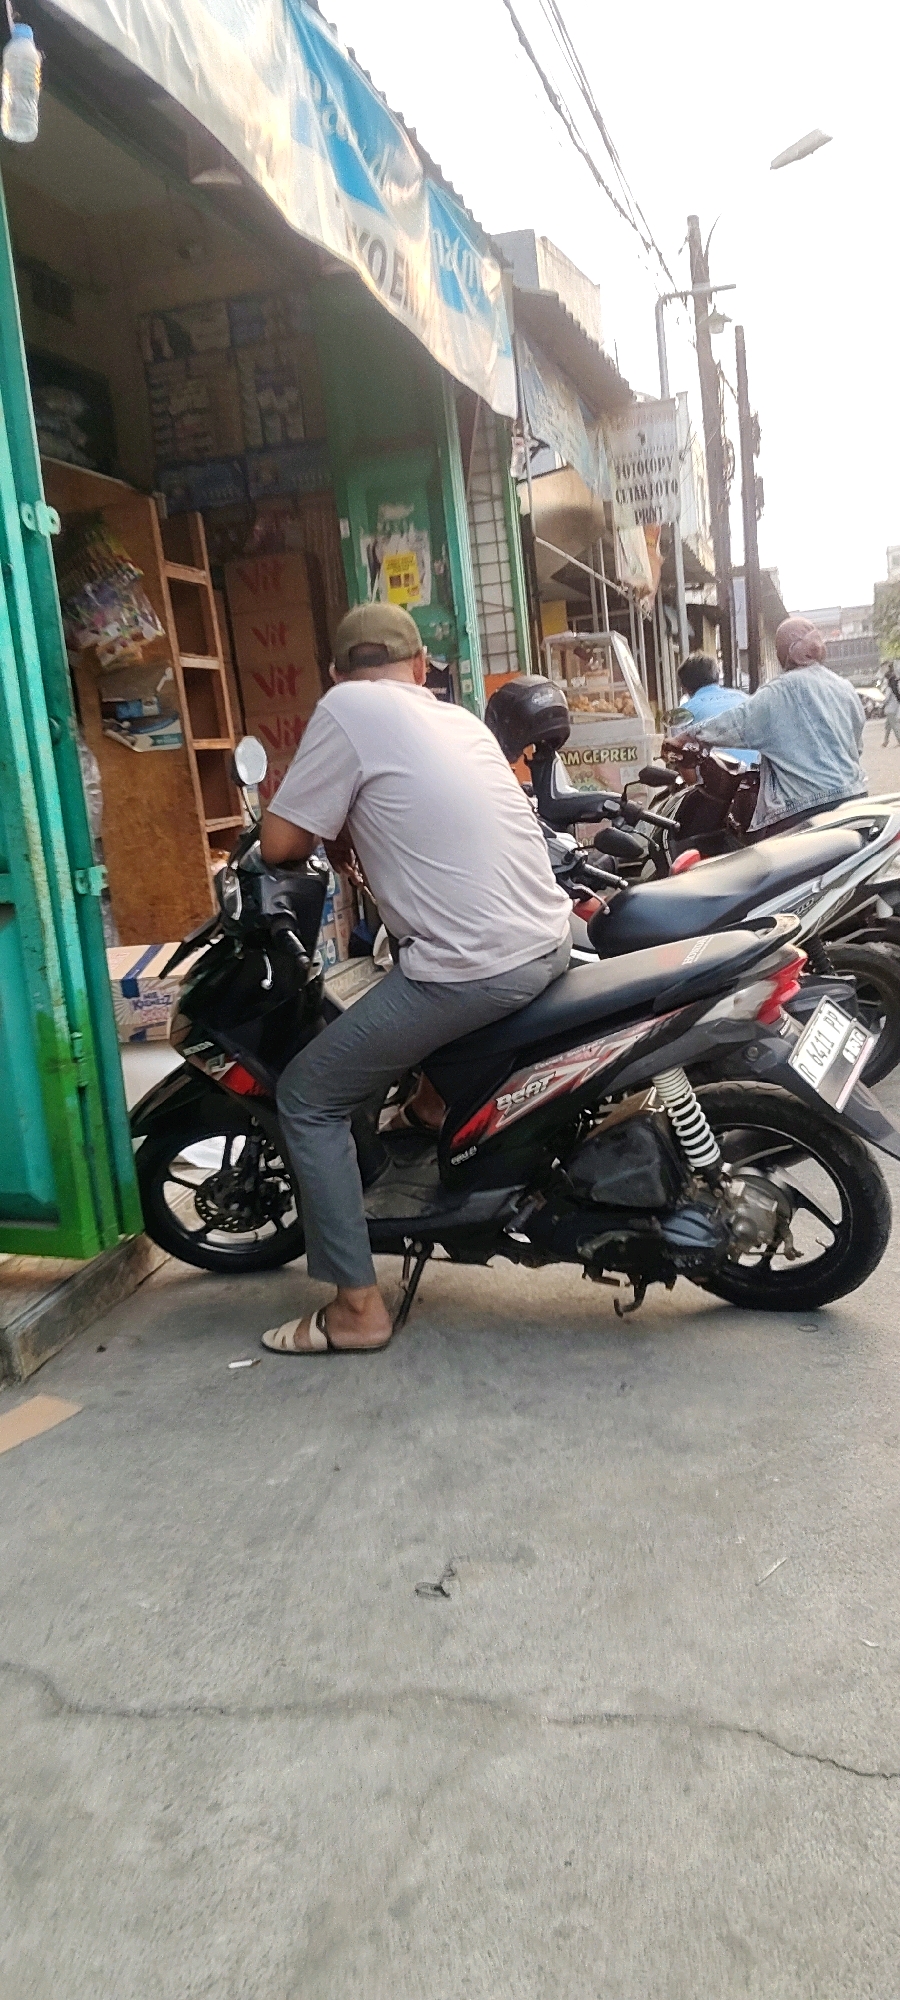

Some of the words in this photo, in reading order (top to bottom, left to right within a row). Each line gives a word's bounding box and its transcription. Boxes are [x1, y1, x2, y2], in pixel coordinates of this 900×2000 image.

[614, 455, 673, 480] FOTOCOPY
[236, 559, 285, 595] Vit
[251, 620, 287, 648] Vit
[252, 662, 303, 698] Vit
[258, 713, 306, 750] Vit
[583, 745, 638, 765] GEPREK
[259, 766, 289, 800] Vi
[806, 1029, 834, 1066] 6411
[823, 1010, 844, 1034] PP
